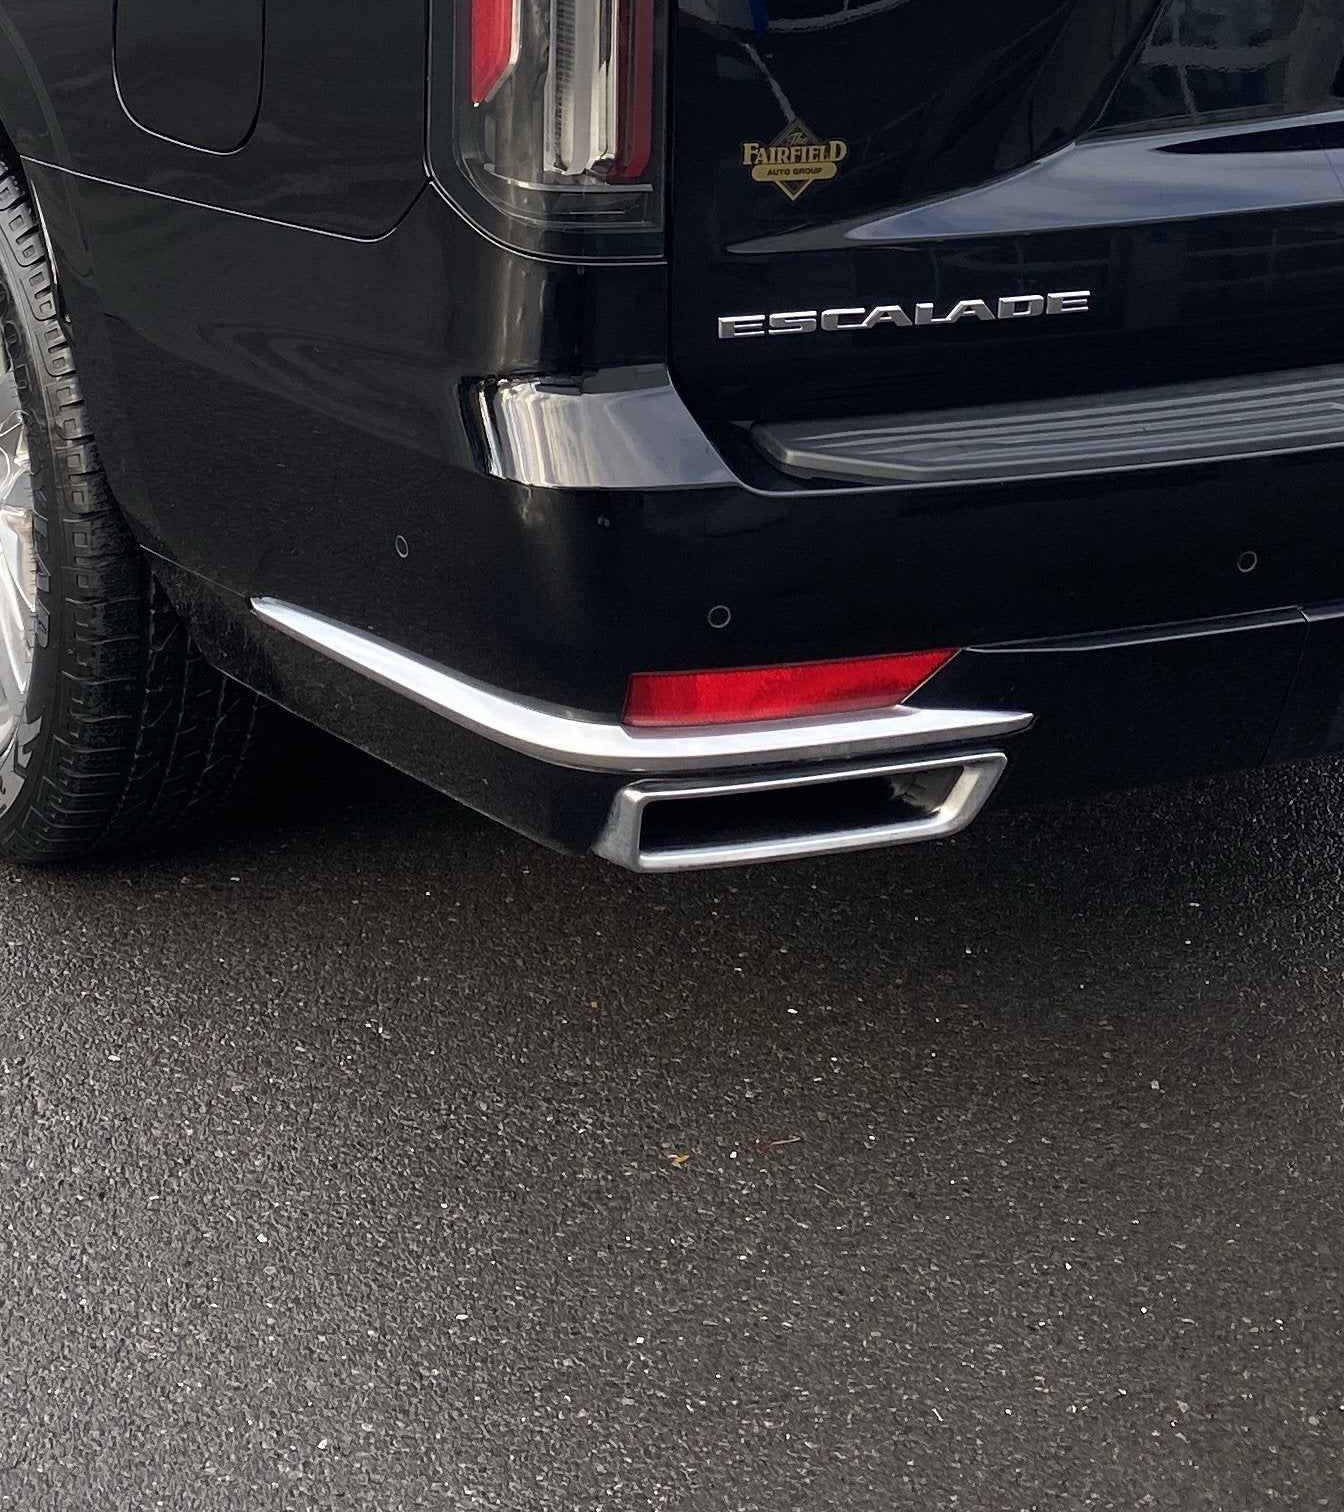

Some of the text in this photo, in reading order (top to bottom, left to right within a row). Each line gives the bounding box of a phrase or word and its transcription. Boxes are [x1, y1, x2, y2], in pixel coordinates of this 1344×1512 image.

[742, 140, 848, 166] FAIRFIELD
[766, 167, 824, 177] AUTO GROUP
[718, 289, 1092, 339] ESCALADE
